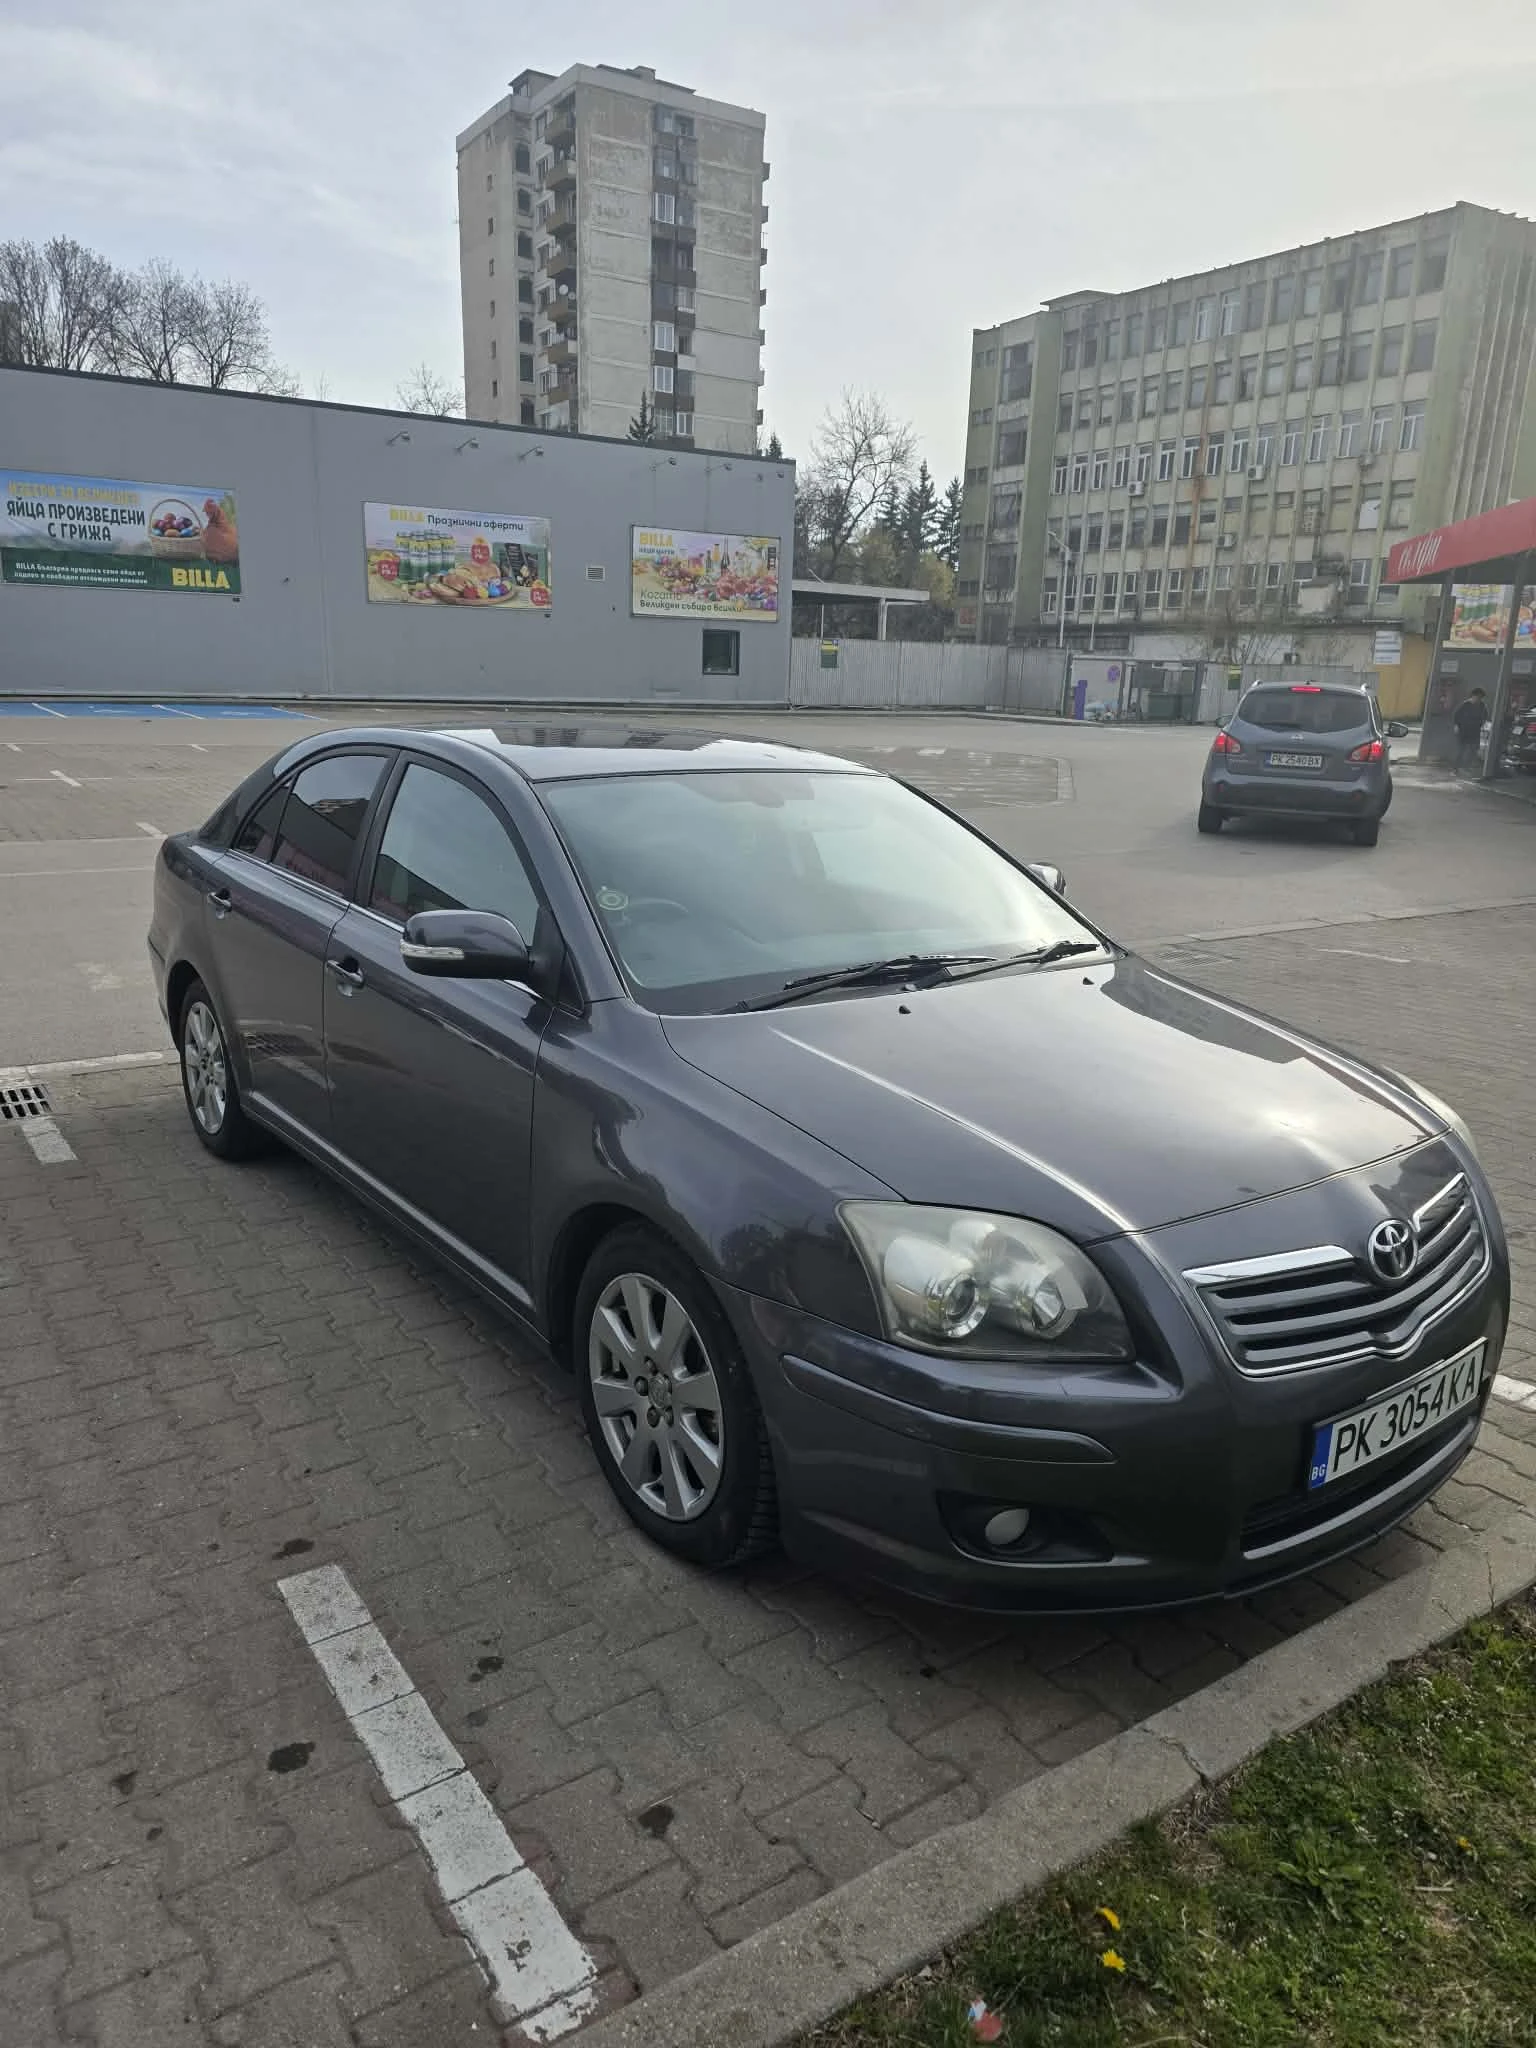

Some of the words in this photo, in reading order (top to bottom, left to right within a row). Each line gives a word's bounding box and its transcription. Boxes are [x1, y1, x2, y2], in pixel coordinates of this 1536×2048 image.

[7, 497, 45, 519] ЯЙЦА
[49, 503, 145, 526] ПРОИЗВЕДЕНИ
[47, 523, 57, 538] С
[61, 524, 112, 541] ГРИЖА
[427, 514, 482, 528] Празнични
[484, 519, 524, 532] оферти
[172, 567, 230, 589] BILLA
[1334, 1411, 1378, 1472] PK
[1312, 1464, 1326, 1481] BG
